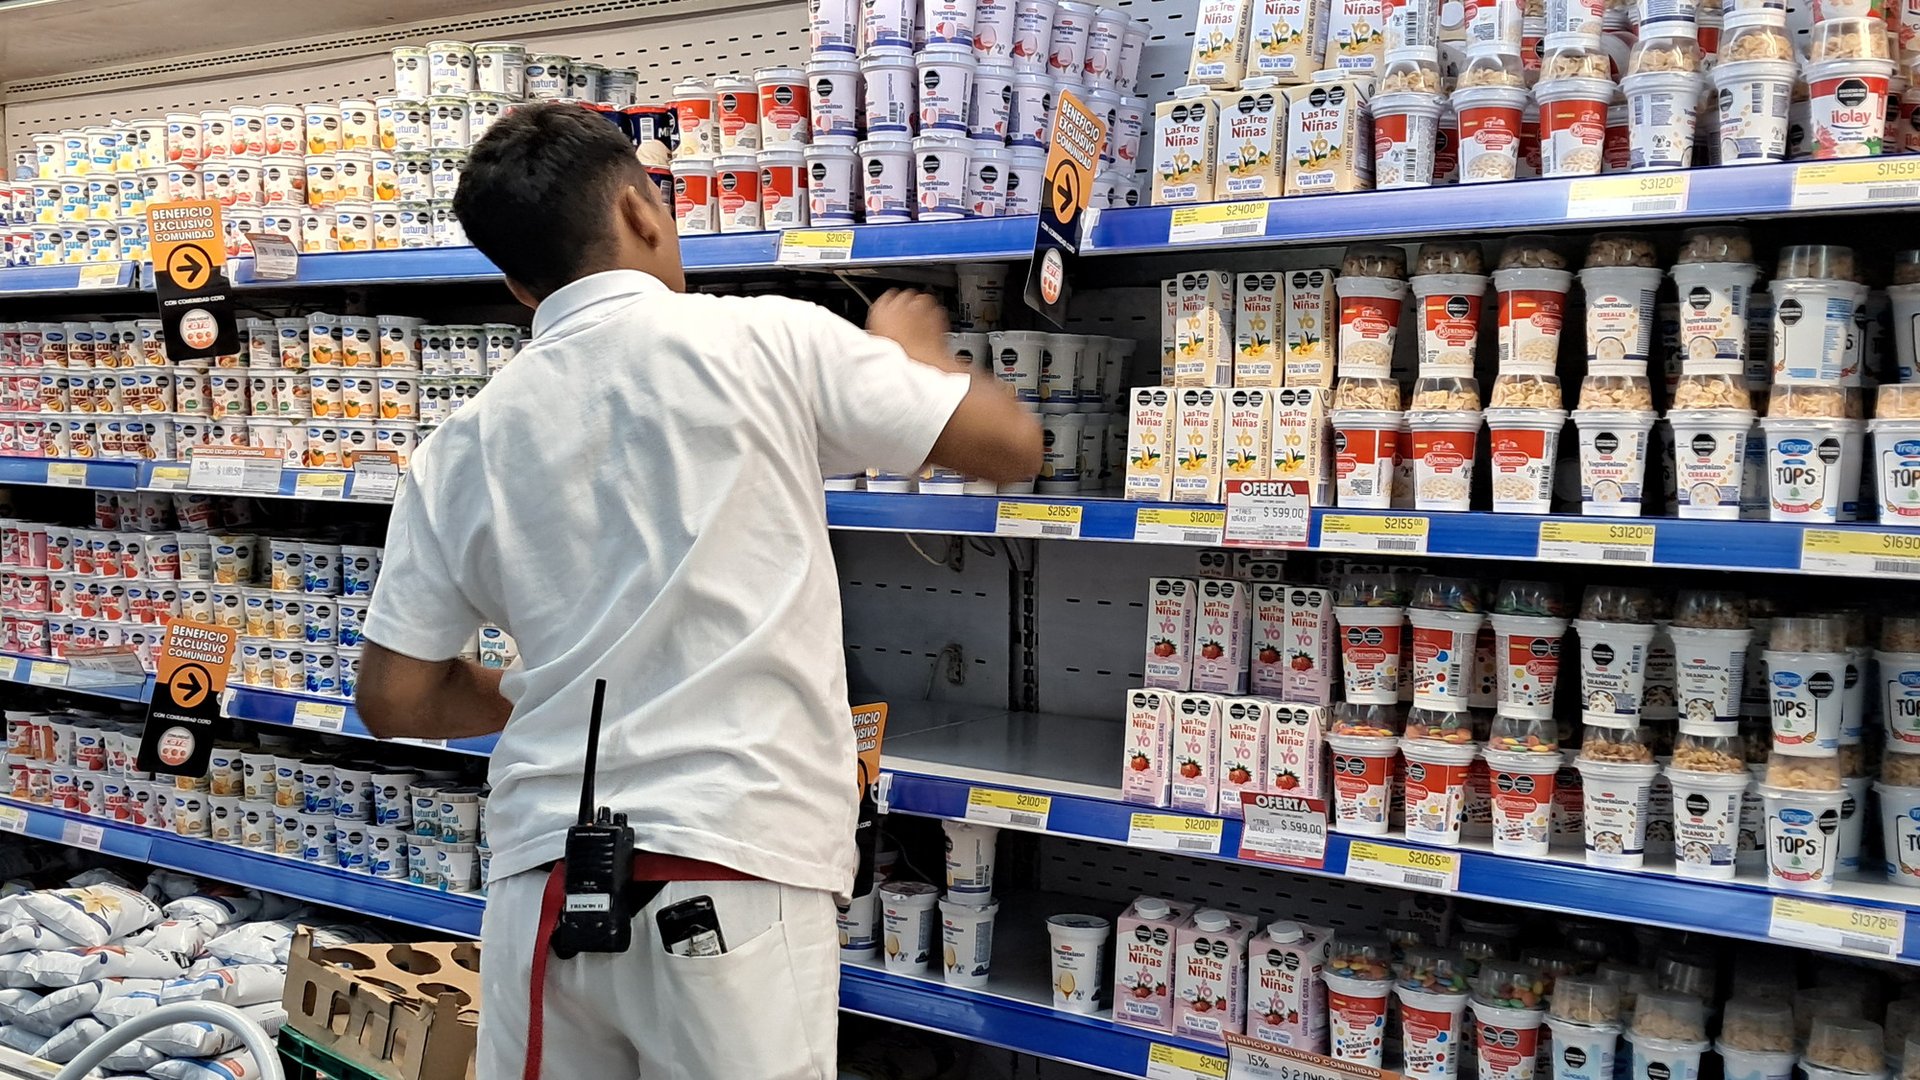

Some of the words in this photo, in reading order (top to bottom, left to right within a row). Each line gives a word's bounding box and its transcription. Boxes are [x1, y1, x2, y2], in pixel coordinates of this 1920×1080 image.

[1205, 4, 1219, 13] Las
[1220, 1, 1235, 11] Tres
[1265, 4, 1300, 15] Niñas
[1344, 4, 1380, 15] Niñas
[1204, 14, 1233, 24] Niñas
[530, 79, 559, 88] natural
[1061, 99, 1100, 142] BENEFICIO
[1231, 117, 1248, 126] Las
[1249, 114, 1268, 124] Tres
[1301, 111, 1319, 121] Las
[1320, 108, 1340, 118] Tres
[1831, 109, 1872, 125] ilolay
[1165, 126, 1181, 135] Las
[1182, 124, 1200, 133] Tres
[1231, 126, 1267, 138] Niñas
[1302, 120, 1338, 132] Niñas
[1058, 116, 1096, 156] EXCLUSIVO
[1165, 135, 1199, 147] Niñas
[1055, 132, 1092, 171] COMUNIDAD
[152, 207, 213, 220] BENEFICIO
[153, 218, 213, 232] EXCLUSIVO
[155, 230, 215, 242] COMUNIDAD
[1305, 292, 1320, 300] Tres
[1244, 302, 1271, 312] Niñas
[1293, 301, 1320, 310] Niñas
[1136, 410, 1149, 418] Las
[1183, 410, 1196, 418] Las
[1196, 410, 1210, 418] Tres
[1245, 410, 1259, 418] Tres
[1293, 409, 1307, 417] Tres
[1137, 417, 1162, 427] Niñas
[1183, 417, 1209, 427] Niñas
[1232, 419, 1258, 428] Niñas
[1280, 418, 1306, 427] Niñas
[1780, 441, 1812, 452] Tregar
[1776, 466, 1816, 486] TOPS
[1892, 469, 1920, 488] TOP
[1240, 481, 1296, 497] OFERTA
[1263, 507, 1269, 518] $
[1168, 599, 1182, 608] Tres
[1217, 601, 1230, 609] Tres
[1155, 606, 1181, 616] Niñas
[1203, 608, 1229, 618] Niñas
[1304, 610, 1318, 619] Tres
[1260, 612, 1284, 623] Niñas
[1291, 617, 1317, 628] Niñas
[172, 624, 229, 643] BENEFICIO
[169, 637, 226, 654] EXCLUSIVO
[168, 648, 224, 664] COMUNIDAD
[1773, 699, 1807, 718] TOPS
[852, 711, 881, 728] EFICIO
[1144, 712, 1156, 721] Tres
[1132, 719, 1155, 730] Niñas
[1194, 718, 1207, 728] Tres
[1229, 723, 1242, 731] Las
[1243, 723, 1257, 733] Tres
[855, 726, 879, 740] USIVO
[1181, 726, 1206, 737] Niñas
[1230, 731, 1256, 741] Niñas
[1276, 728, 1289, 736] Las
[1290, 728, 1305, 738] Tres
[857, 740, 877, 753] NIDAD
[1276, 736, 1304, 747] Niñas
[1255, 794, 1312, 813] OFERTA
[1281, 819, 1287, 831] $
[1776, 836, 1817, 856] TOPS
[1128, 943, 1144, 952] Las
[1145, 943, 1163, 957] Tres
[1128, 952, 1162, 968] Niñas
[1187, 956, 1203, 965] Las
[1204, 957, 1223, 970] Tres
[1188, 965, 1222, 981] Niñas
[1260, 967, 1276, 976] Las
[1276, 969, 1295, 982] Tres
[1260, 976, 1294, 993] Niñas
[1226, 1034, 1271, 1051] BENEFICIO
[1272, 1045, 1321, 1063] EXCLUSIVO
[1323, 1058, 1381, 1078] COMUNIDAD
[1246, 1053, 1270, 1070] 15%
